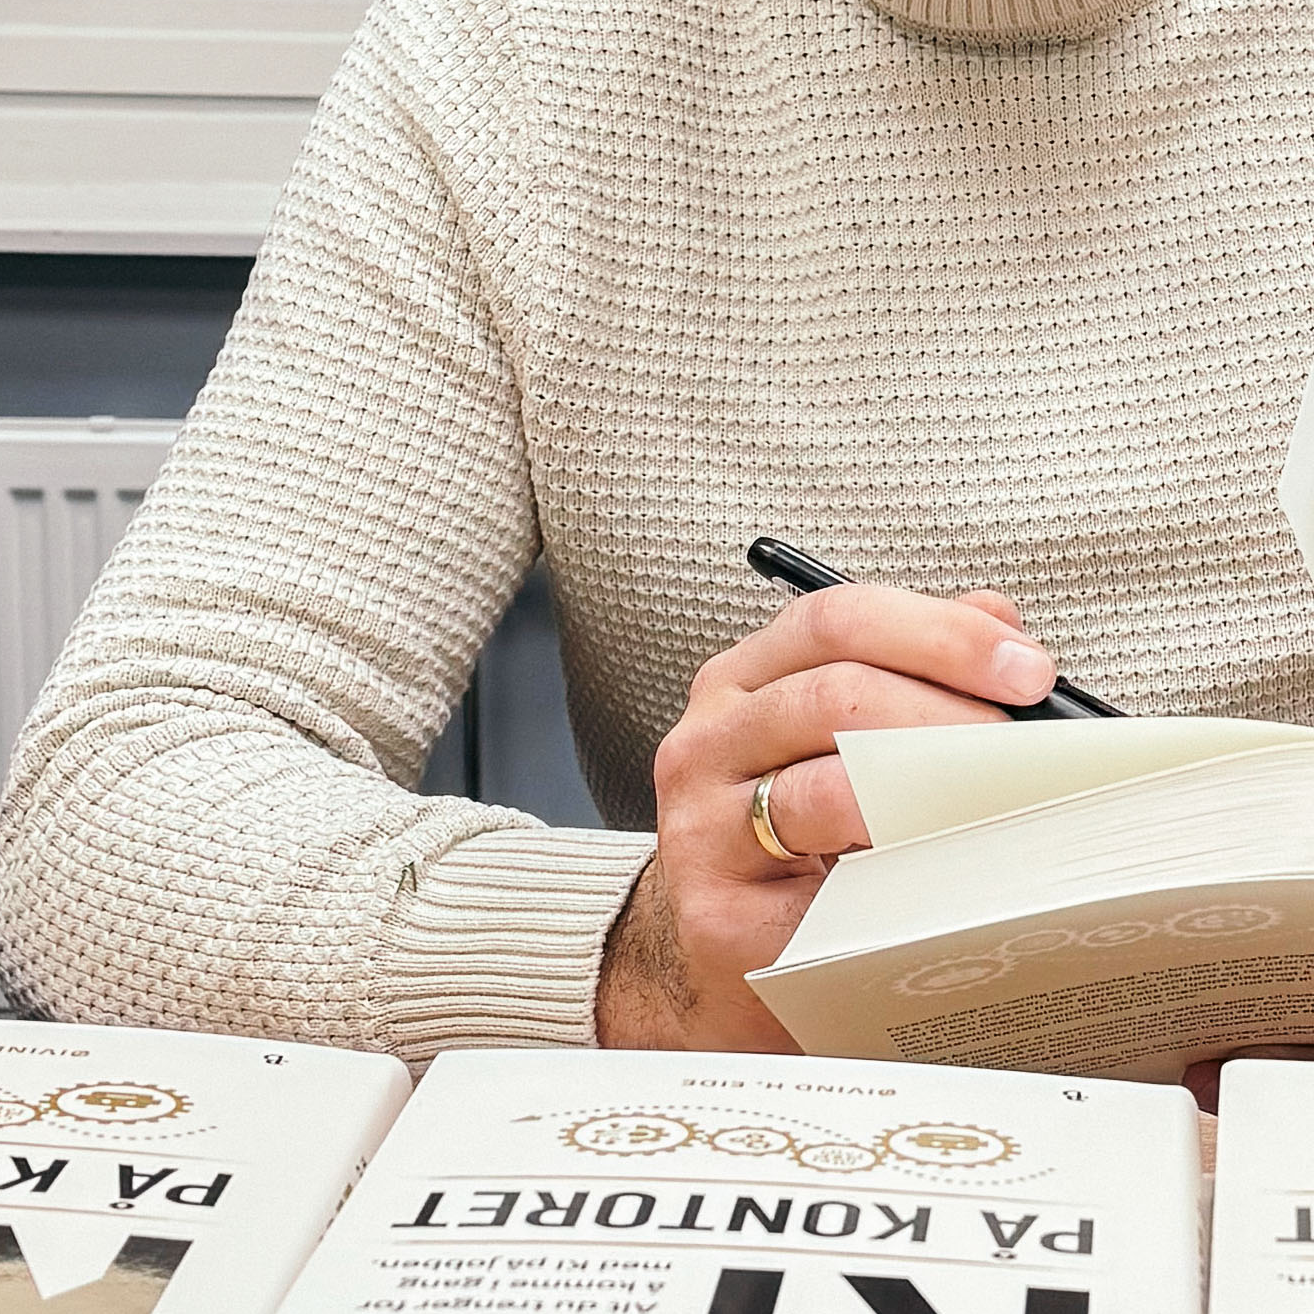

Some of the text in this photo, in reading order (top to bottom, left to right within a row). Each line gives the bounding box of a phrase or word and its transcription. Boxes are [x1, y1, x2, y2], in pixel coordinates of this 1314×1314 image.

[682, 1078, 745, 1088] EIDE
[795, 1083, 897, 1097] ØIVIND
[0, 1155, 233, 1210] PÅ K
[391, 1190, 932, 1243] KONTORET
[981, 1209, 1095, 1260] PÅ
[372, 1254, 503, 1272] jobben.
[556, 1258, 589, 1270] KI
[599, 1258, 672, 1272] med
[398, 1276, 485, 1289] gang
[509, 1277, 637, 1291] komme
[356, 1298, 406, 1313] for
[413, 1297, 544, 1311] trenger
[554, 1299, 599, 1312] du
